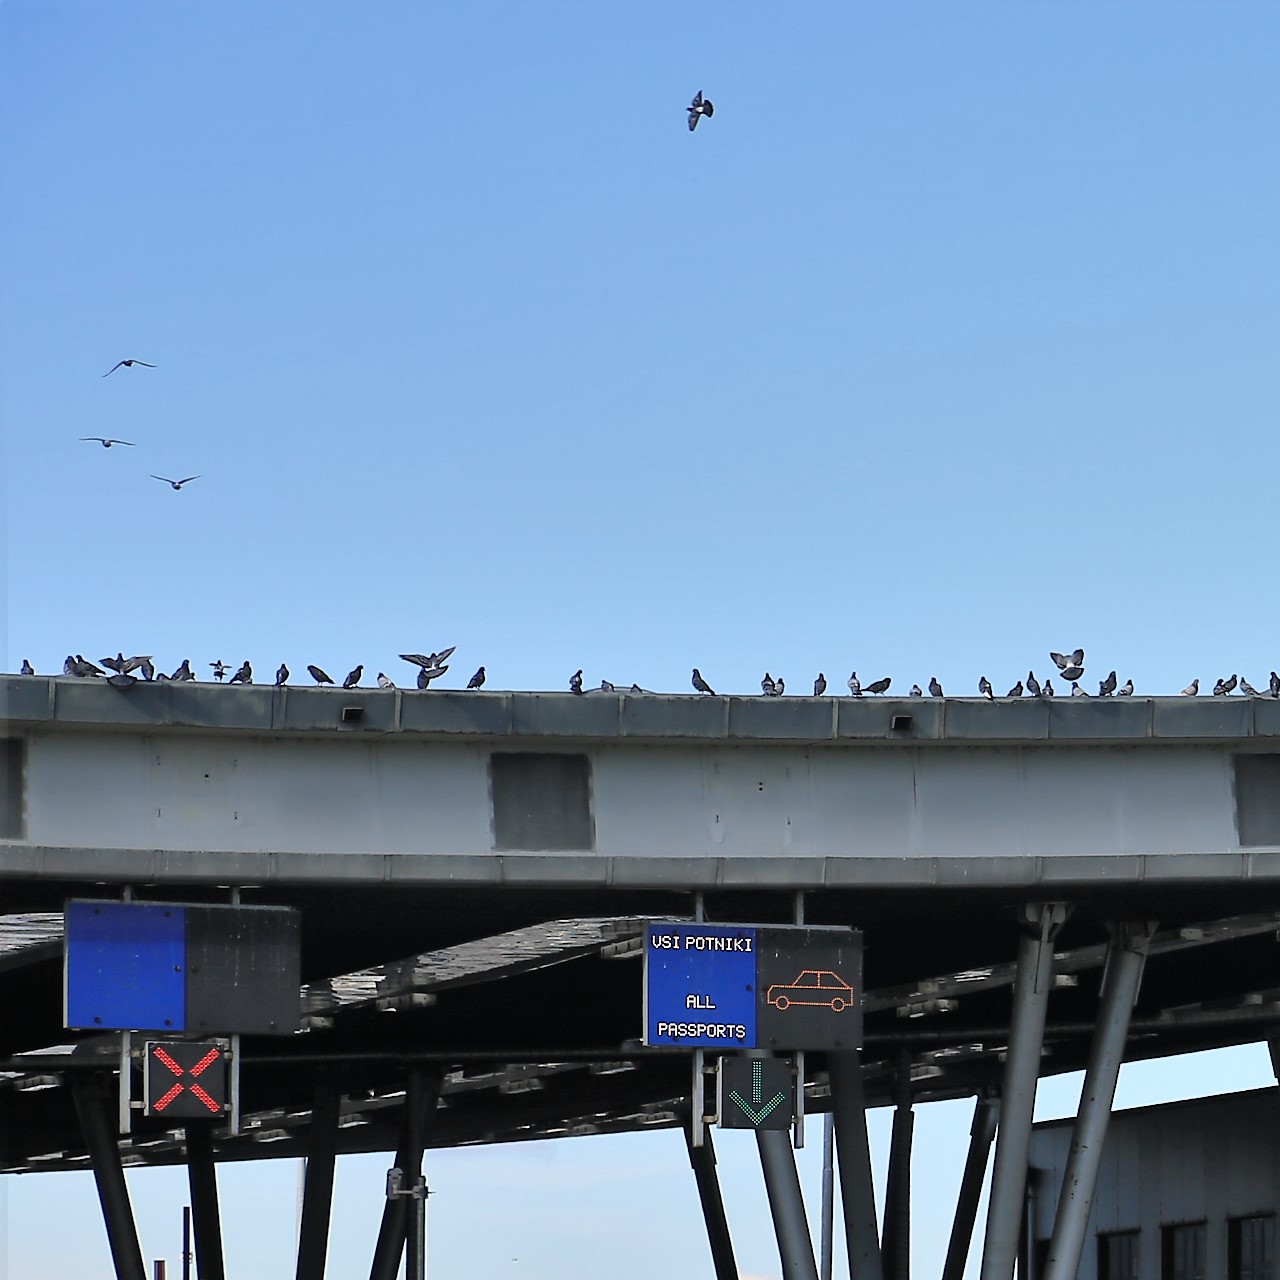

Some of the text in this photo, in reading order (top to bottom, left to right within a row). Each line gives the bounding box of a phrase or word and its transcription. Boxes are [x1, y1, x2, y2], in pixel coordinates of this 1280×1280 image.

[652, 935, 752, 952] VSI POTNIKI
[686, 994, 716, 1009] ALL
[658, 1022, 746, 1038] PASSPORTS
